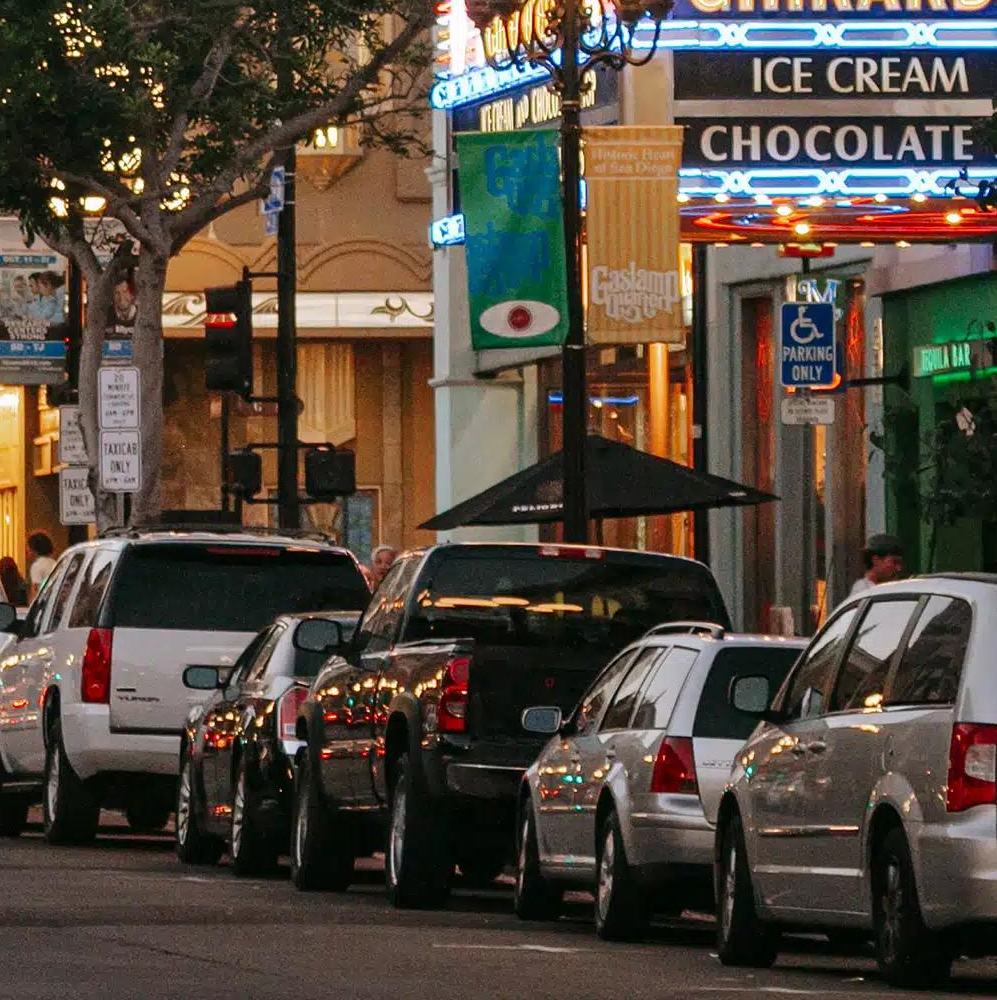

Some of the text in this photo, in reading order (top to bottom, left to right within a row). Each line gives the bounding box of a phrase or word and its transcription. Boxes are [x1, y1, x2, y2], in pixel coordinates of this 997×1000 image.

[753, 57, 969, 93] ICE CREAM
[702, 125, 973, 161] CHOCOLATE
[591, 261, 679, 313] Gaslamp
[783, 345, 833, 362] PARKING
[952, 343, 971, 367] BAR
[792, 365, 823, 381] ONLY
[104, 442, 137, 455] TAXICAB
[110, 460, 130, 473] ONLY
